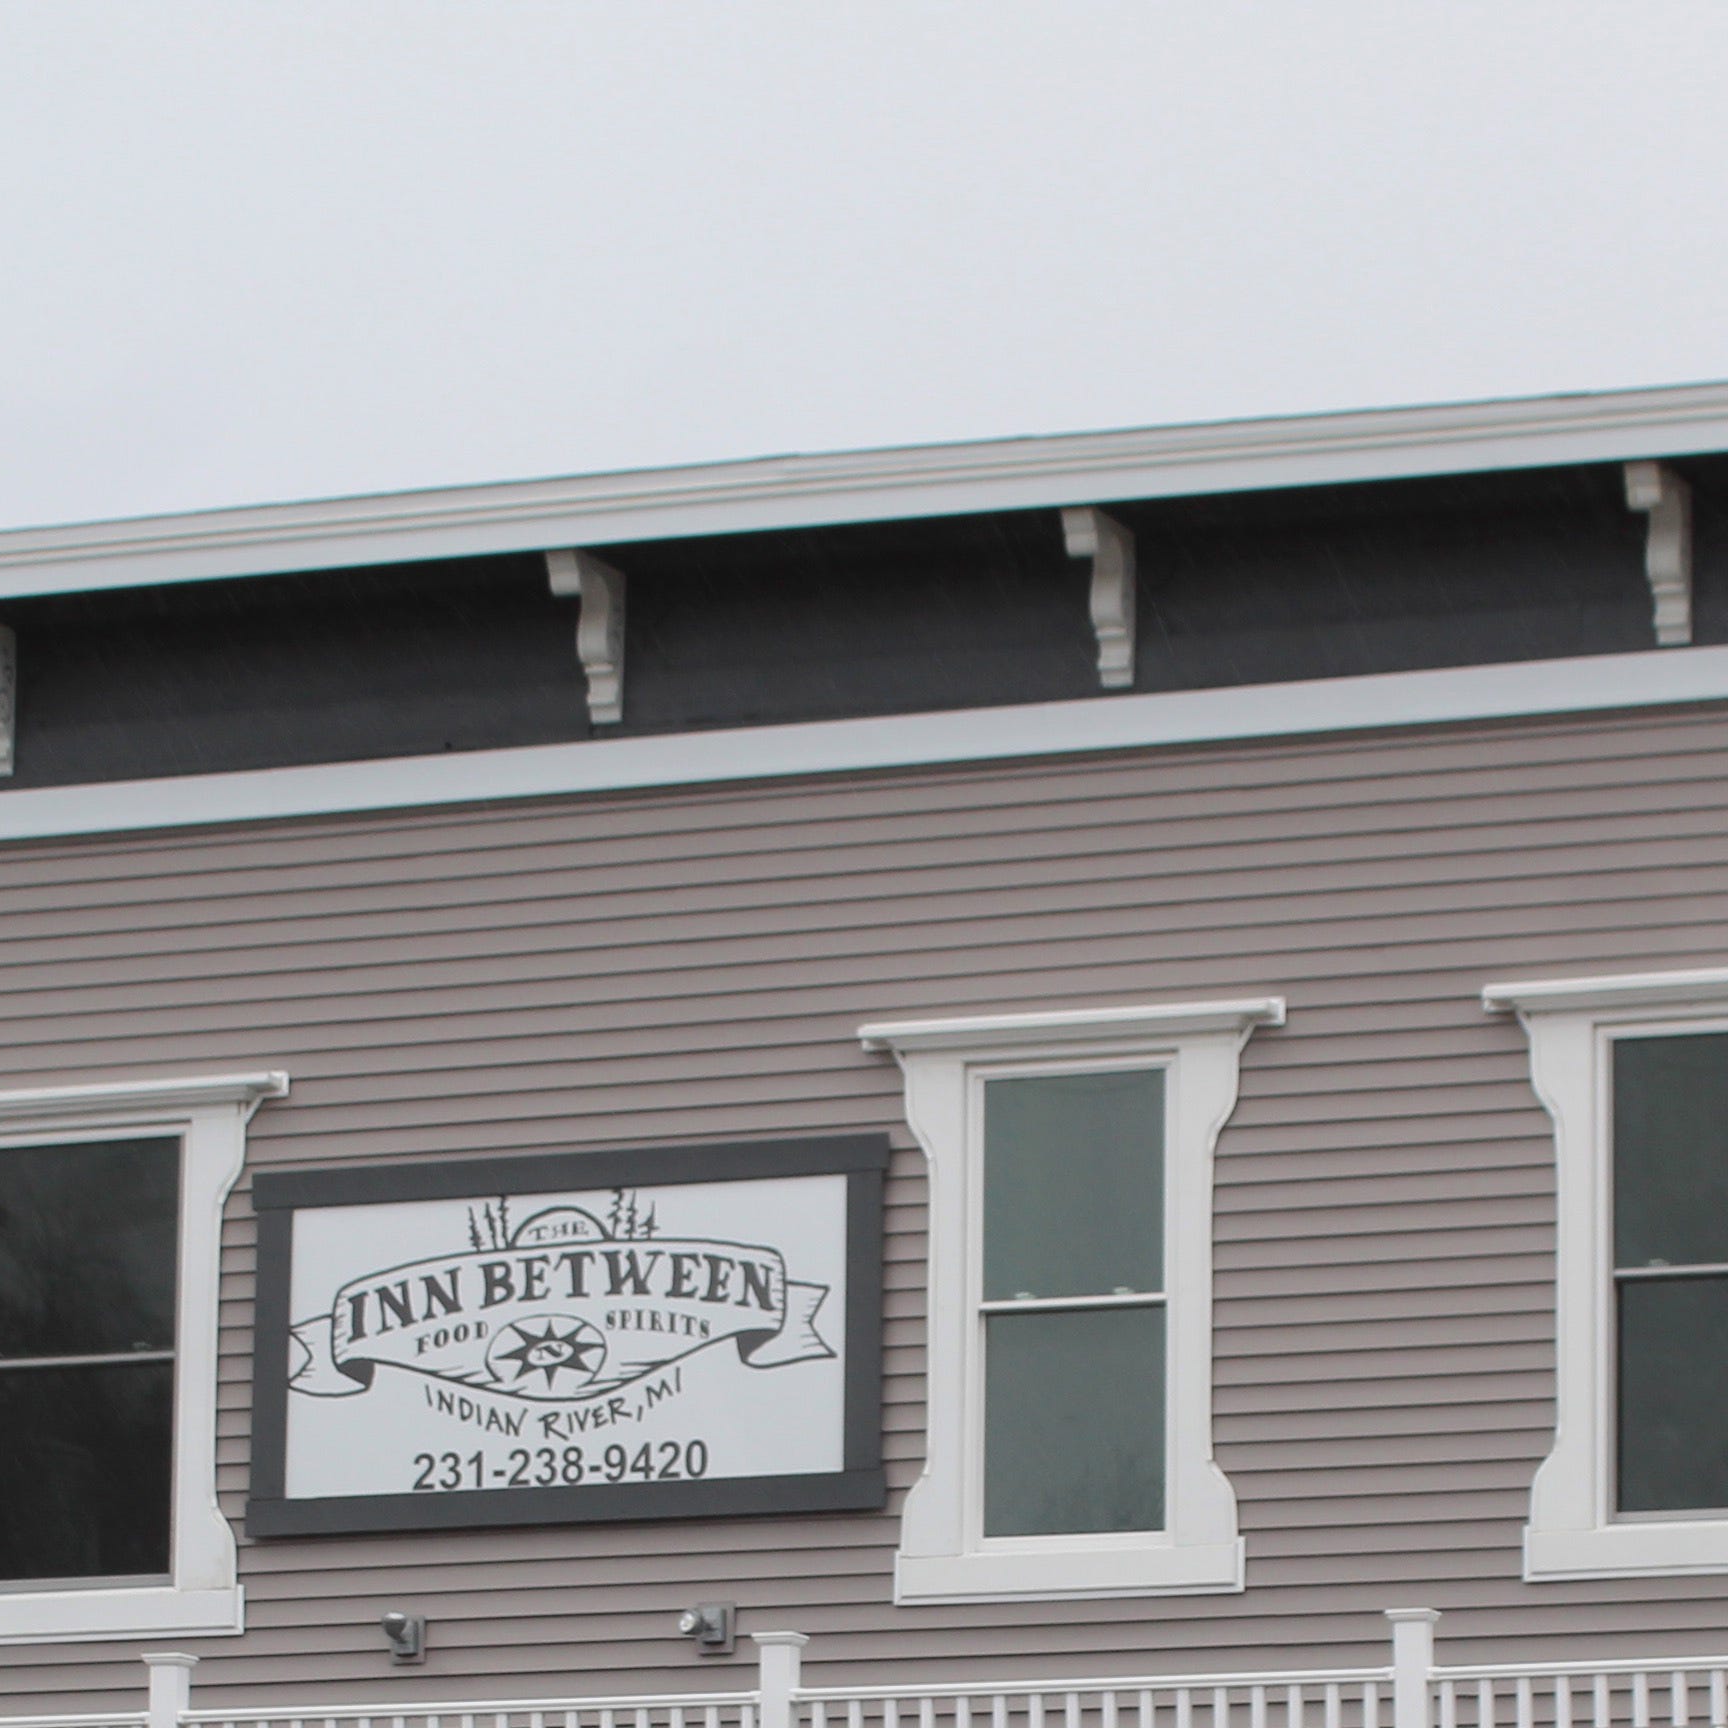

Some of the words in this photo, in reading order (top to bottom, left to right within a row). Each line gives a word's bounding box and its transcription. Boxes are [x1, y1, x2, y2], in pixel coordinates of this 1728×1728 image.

[528, 1221, 590, 1241] THE
[347, 1267, 463, 1344] INN
[478, 1249, 777, 1312] BETWEEN
[414, 1320, 490, 1355] FOOD
[604, 1309, 712, 1338] SPIRITS
[425, 1384, 529, 1438] INDIAN
[538, 1398, 644, 1441] RIVER,
[646, 1366, 682, 1409] MI
[412, 1440, 709, 1491] 231-238-9420
